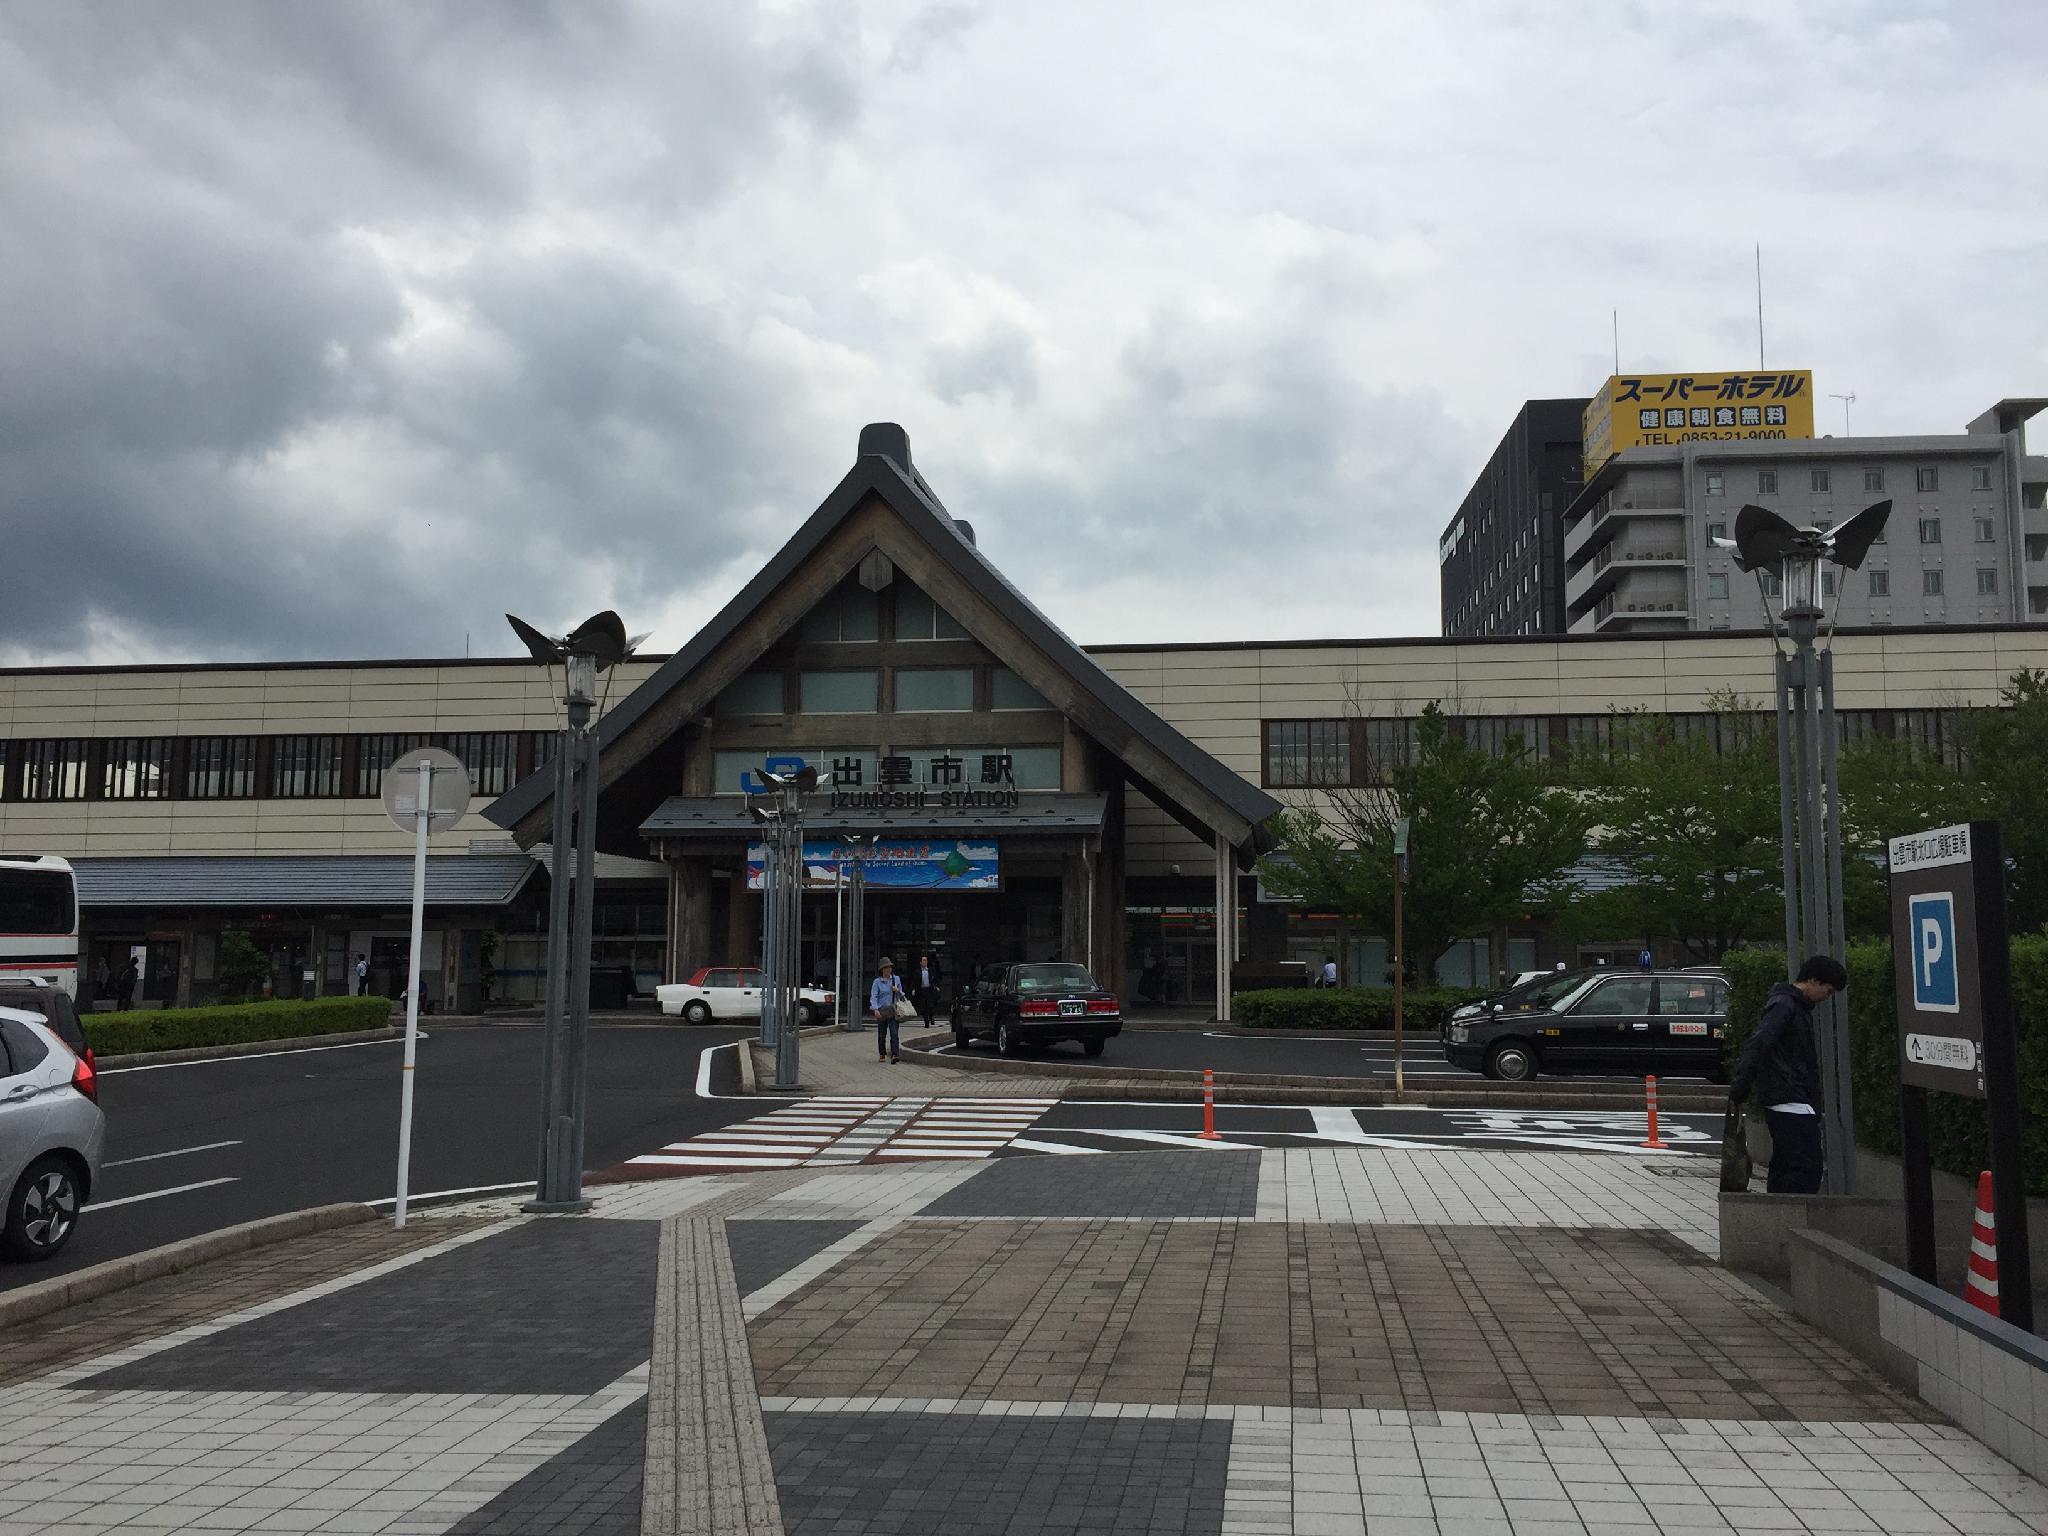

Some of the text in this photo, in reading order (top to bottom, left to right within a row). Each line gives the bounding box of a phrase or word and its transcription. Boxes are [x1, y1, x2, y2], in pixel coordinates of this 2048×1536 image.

[1616, 375, 1805, 402] スーパーホテル
[1640, 406, 1786, 428] 健康朝食無料
[832, 755, 1014, 786] 出雲市駅
[831, 791, 1018, 809] IZUMOSHI STATION
[1922, 918, 1943, 987] P
